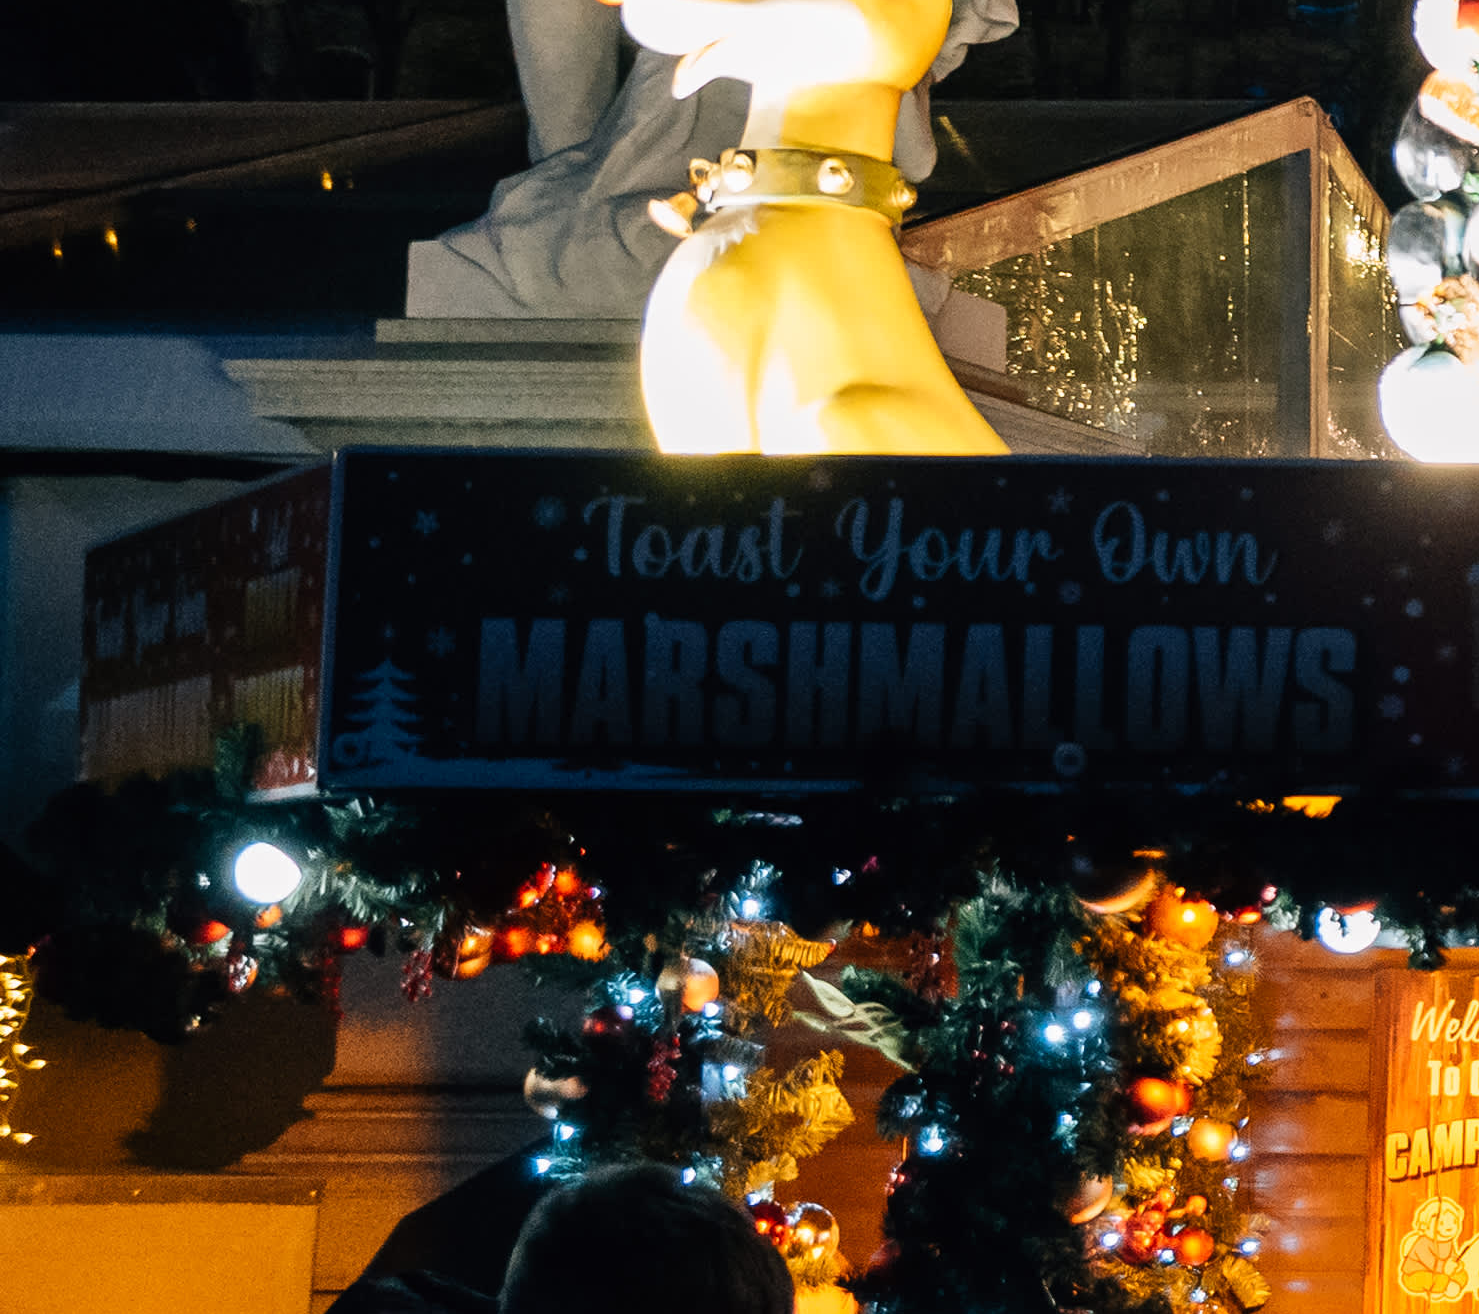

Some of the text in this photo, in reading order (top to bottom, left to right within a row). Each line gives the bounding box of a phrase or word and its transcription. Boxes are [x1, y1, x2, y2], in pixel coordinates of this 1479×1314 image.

[582, 493, 1280, 603] Toast Your Own
[475, 616, 1358, 754] MARSHMALLOWS
[1426, 1059, 1461, 1096] To
